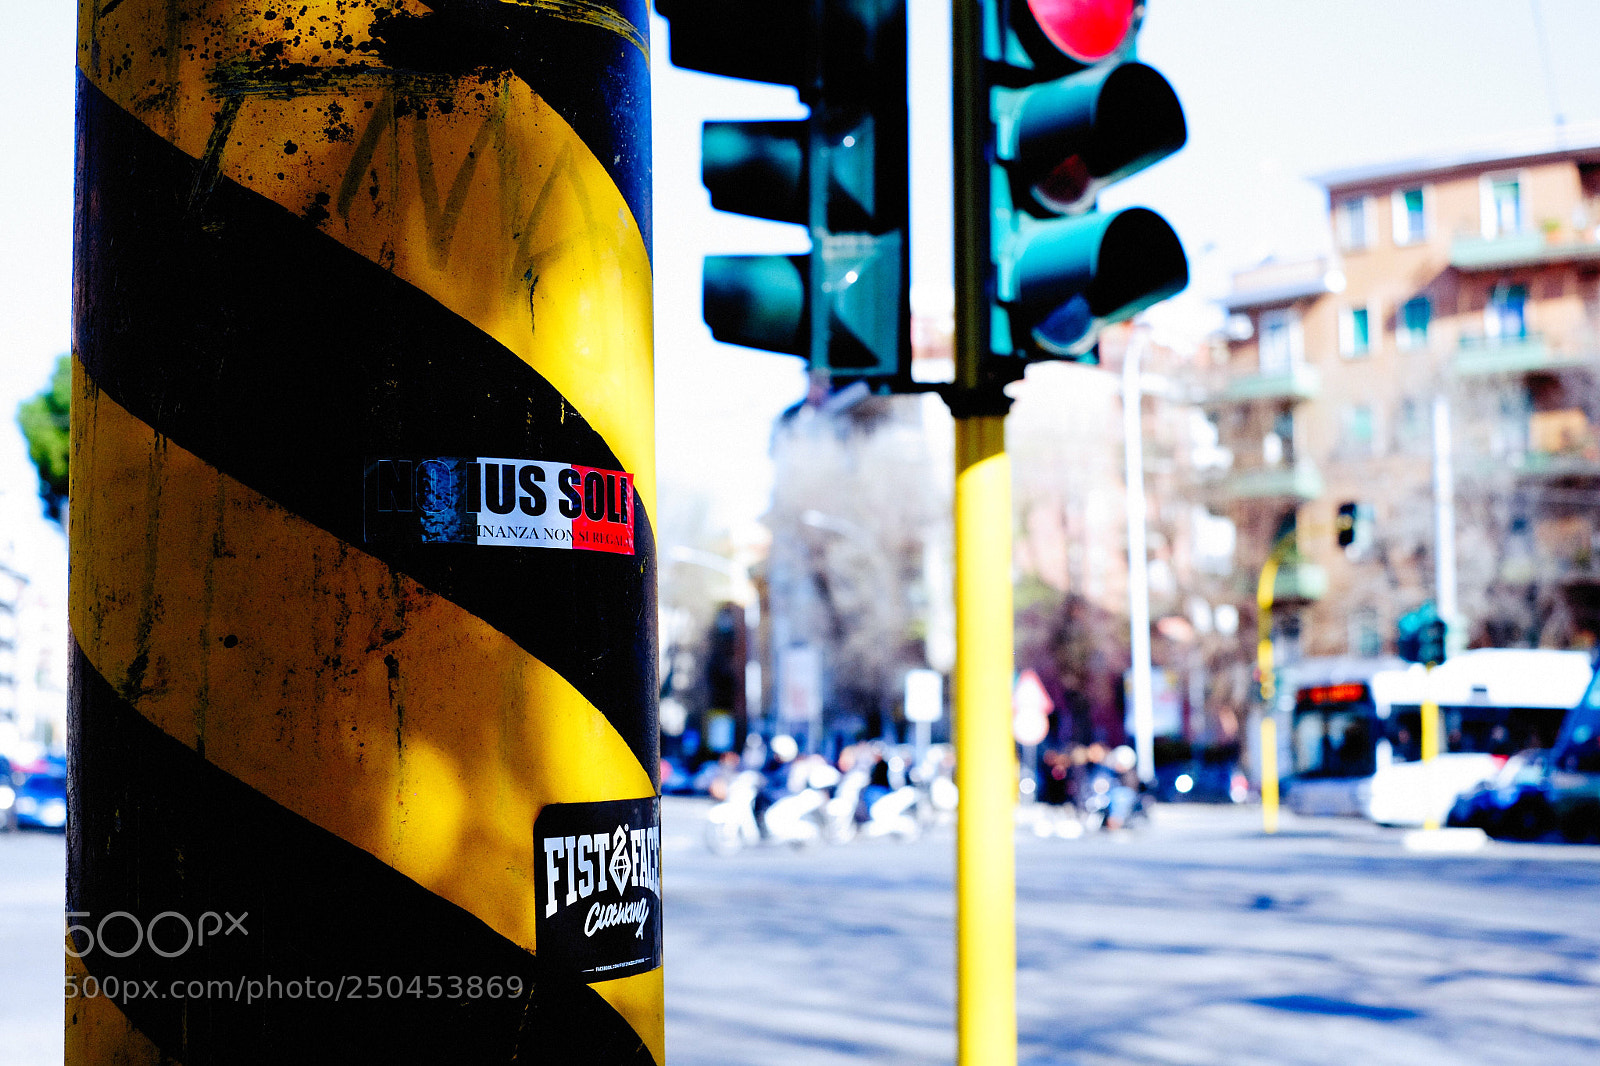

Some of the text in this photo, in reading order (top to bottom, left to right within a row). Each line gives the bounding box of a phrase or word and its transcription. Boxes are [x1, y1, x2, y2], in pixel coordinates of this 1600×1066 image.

[378, 459, 629, 526] NO IUS SOLI
[543, 527, 574, 542] NON
[543, 832, 610, 919] FIST
[630, 826, 661, 900] FACE
